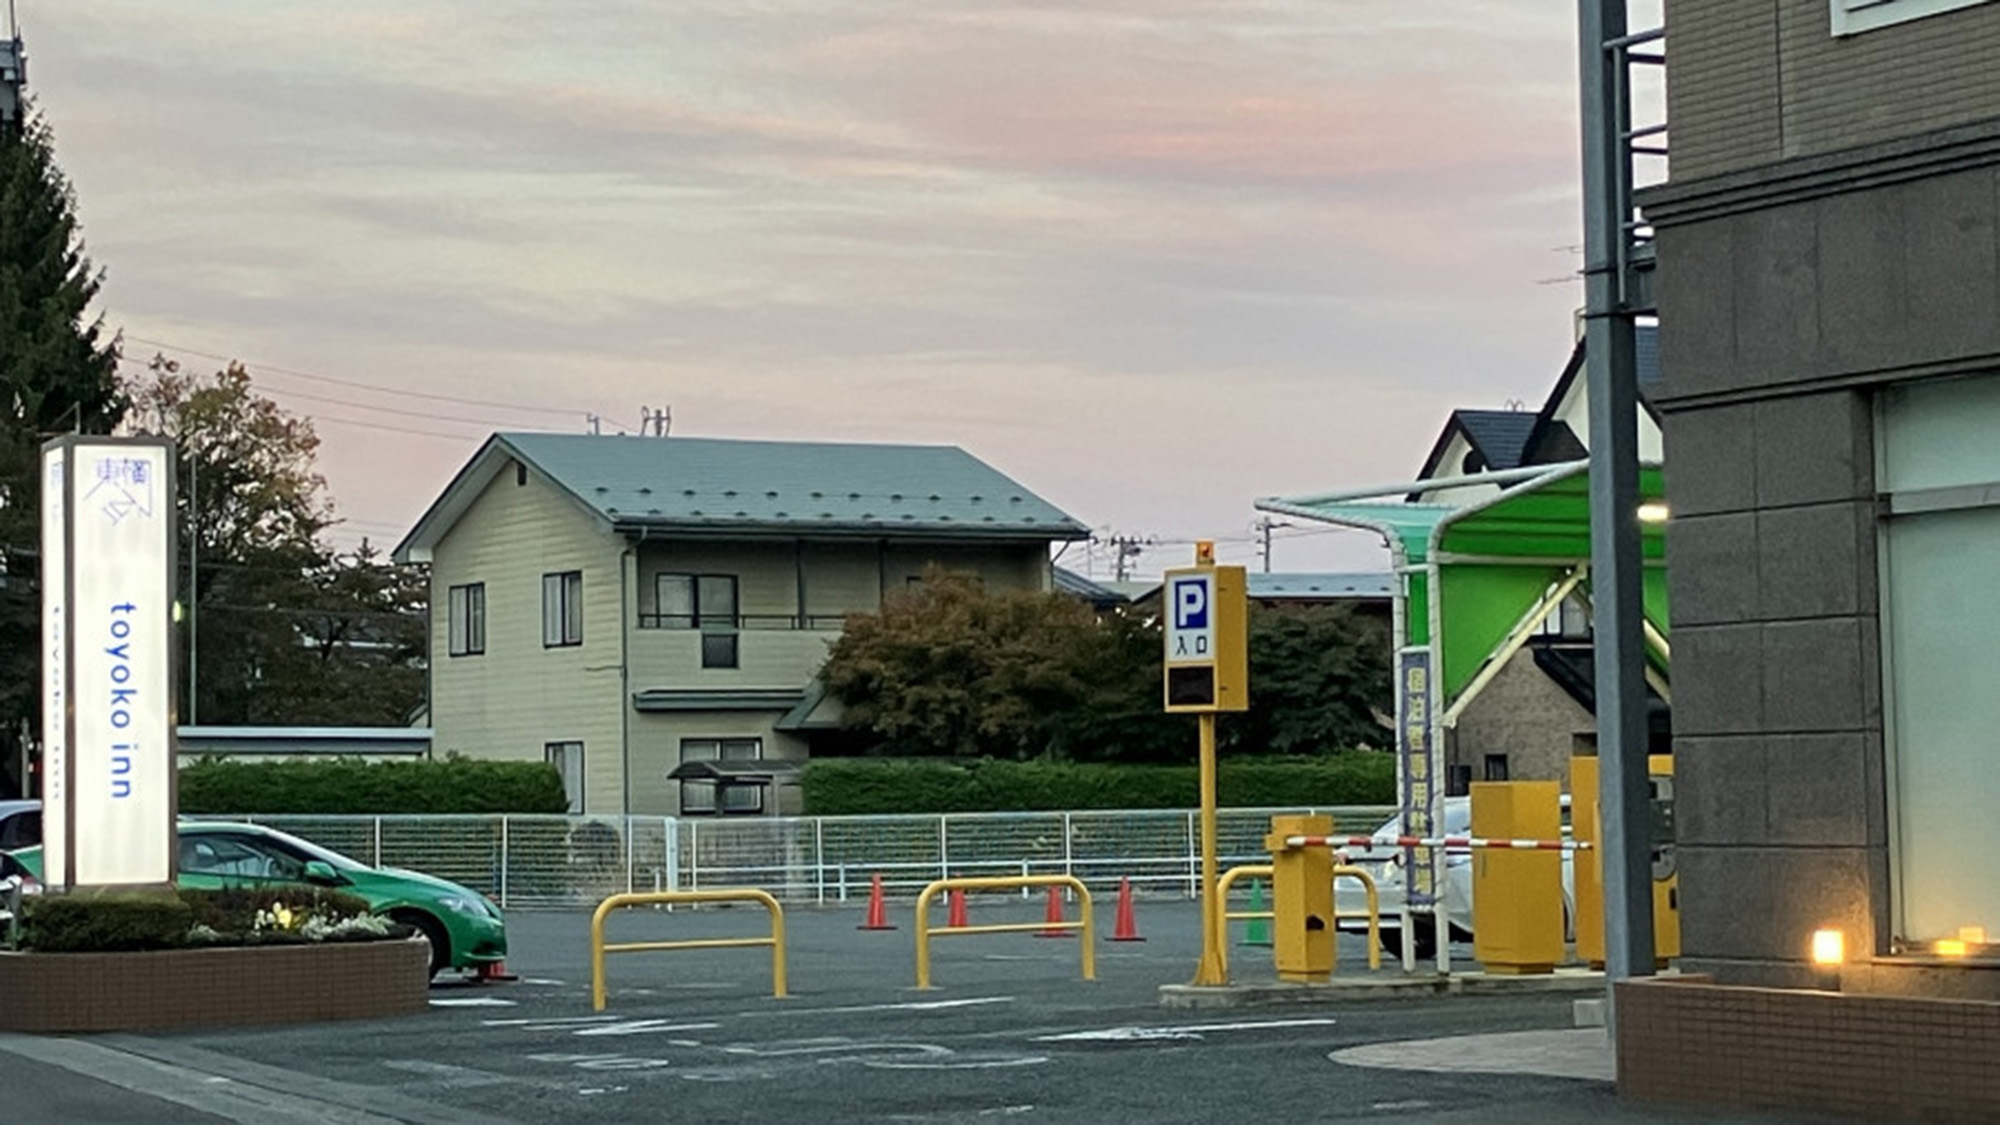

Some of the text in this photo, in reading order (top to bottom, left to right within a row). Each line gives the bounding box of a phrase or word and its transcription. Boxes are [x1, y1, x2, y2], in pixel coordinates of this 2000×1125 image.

[1178, 583, 1205, 627] P
[1175, 635, 1208, 656] 入口
[105, 602, 138, 798] toyoko inn
